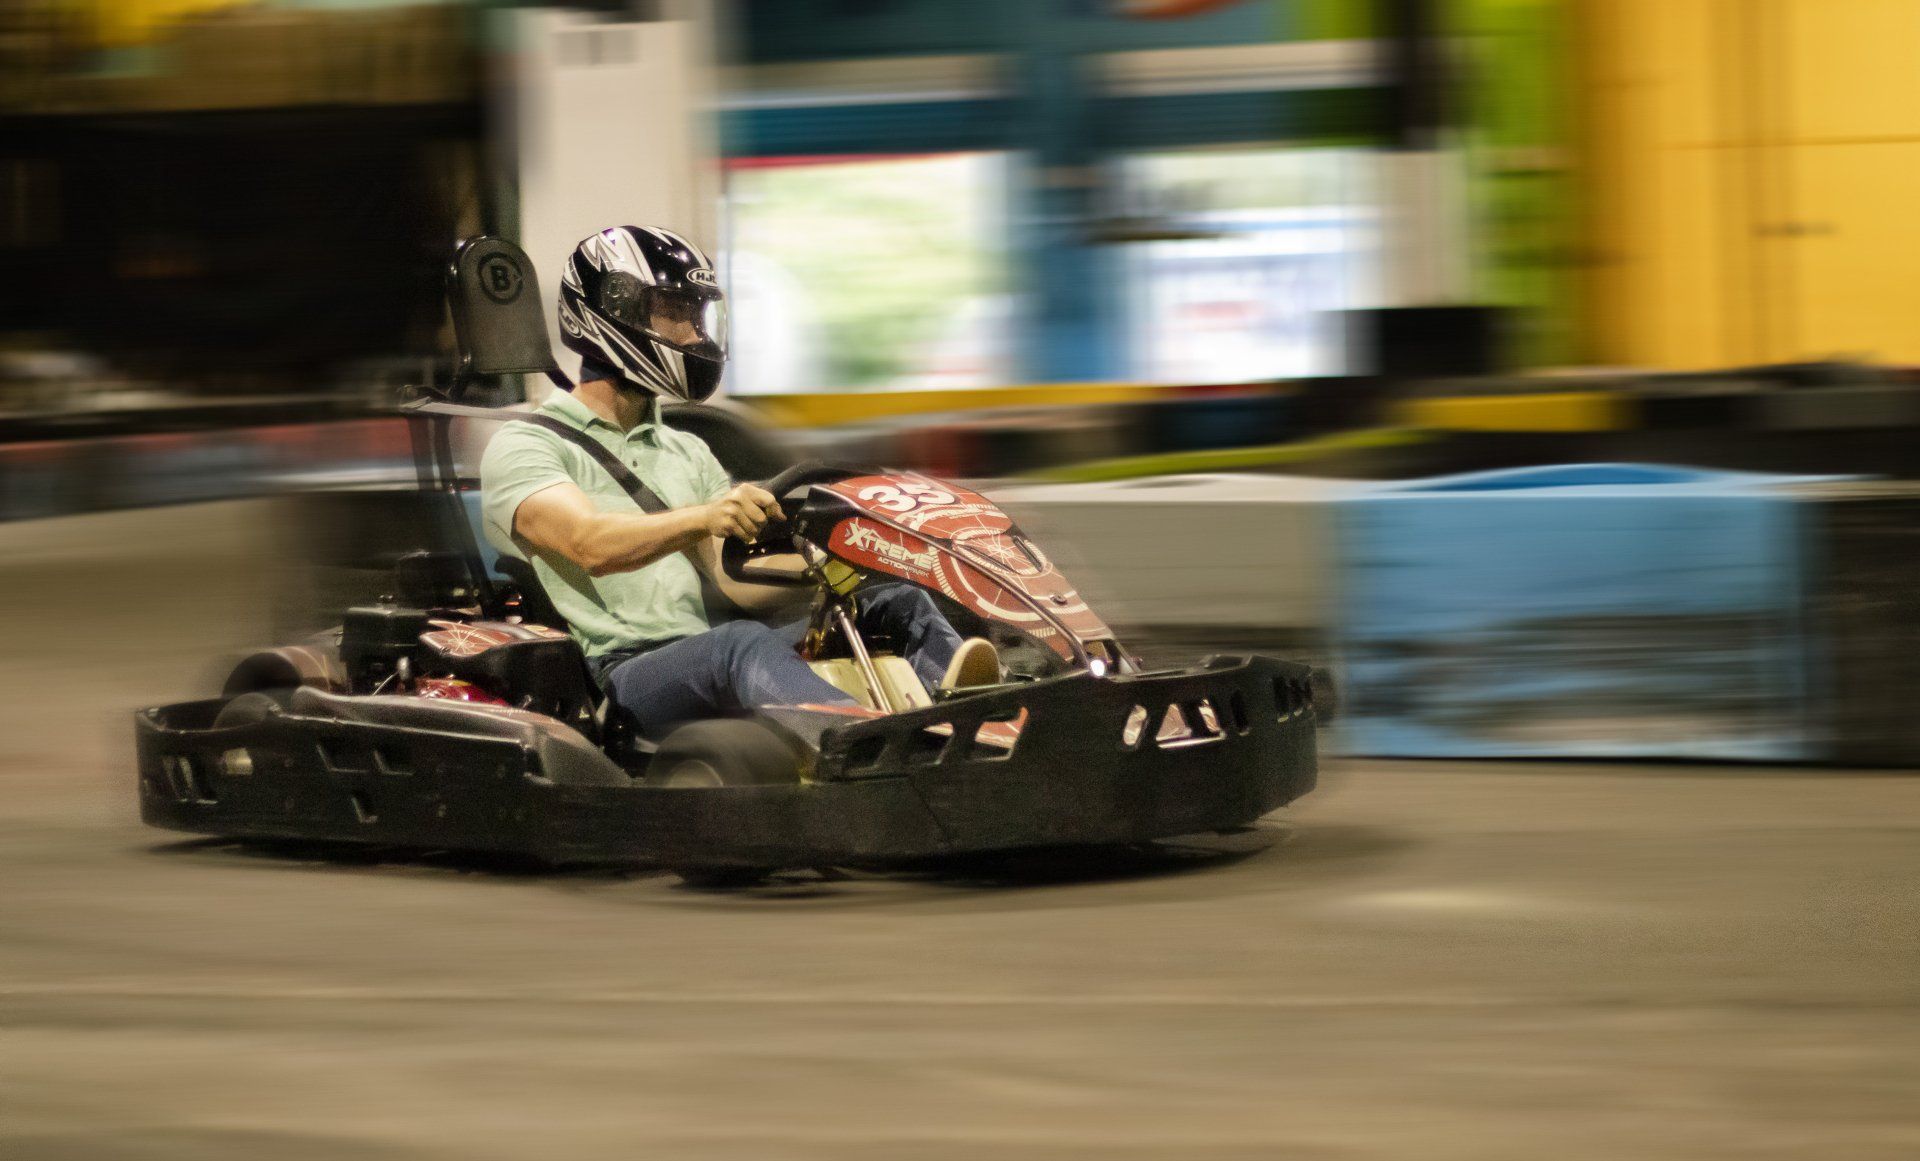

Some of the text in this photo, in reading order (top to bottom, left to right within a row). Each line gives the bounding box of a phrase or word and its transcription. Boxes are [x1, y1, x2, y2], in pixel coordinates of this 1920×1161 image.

[858, 484, 955, 511] 35
[844, 522, 933, 570] XTREME
[878, 557, 909, 571] ACTION
